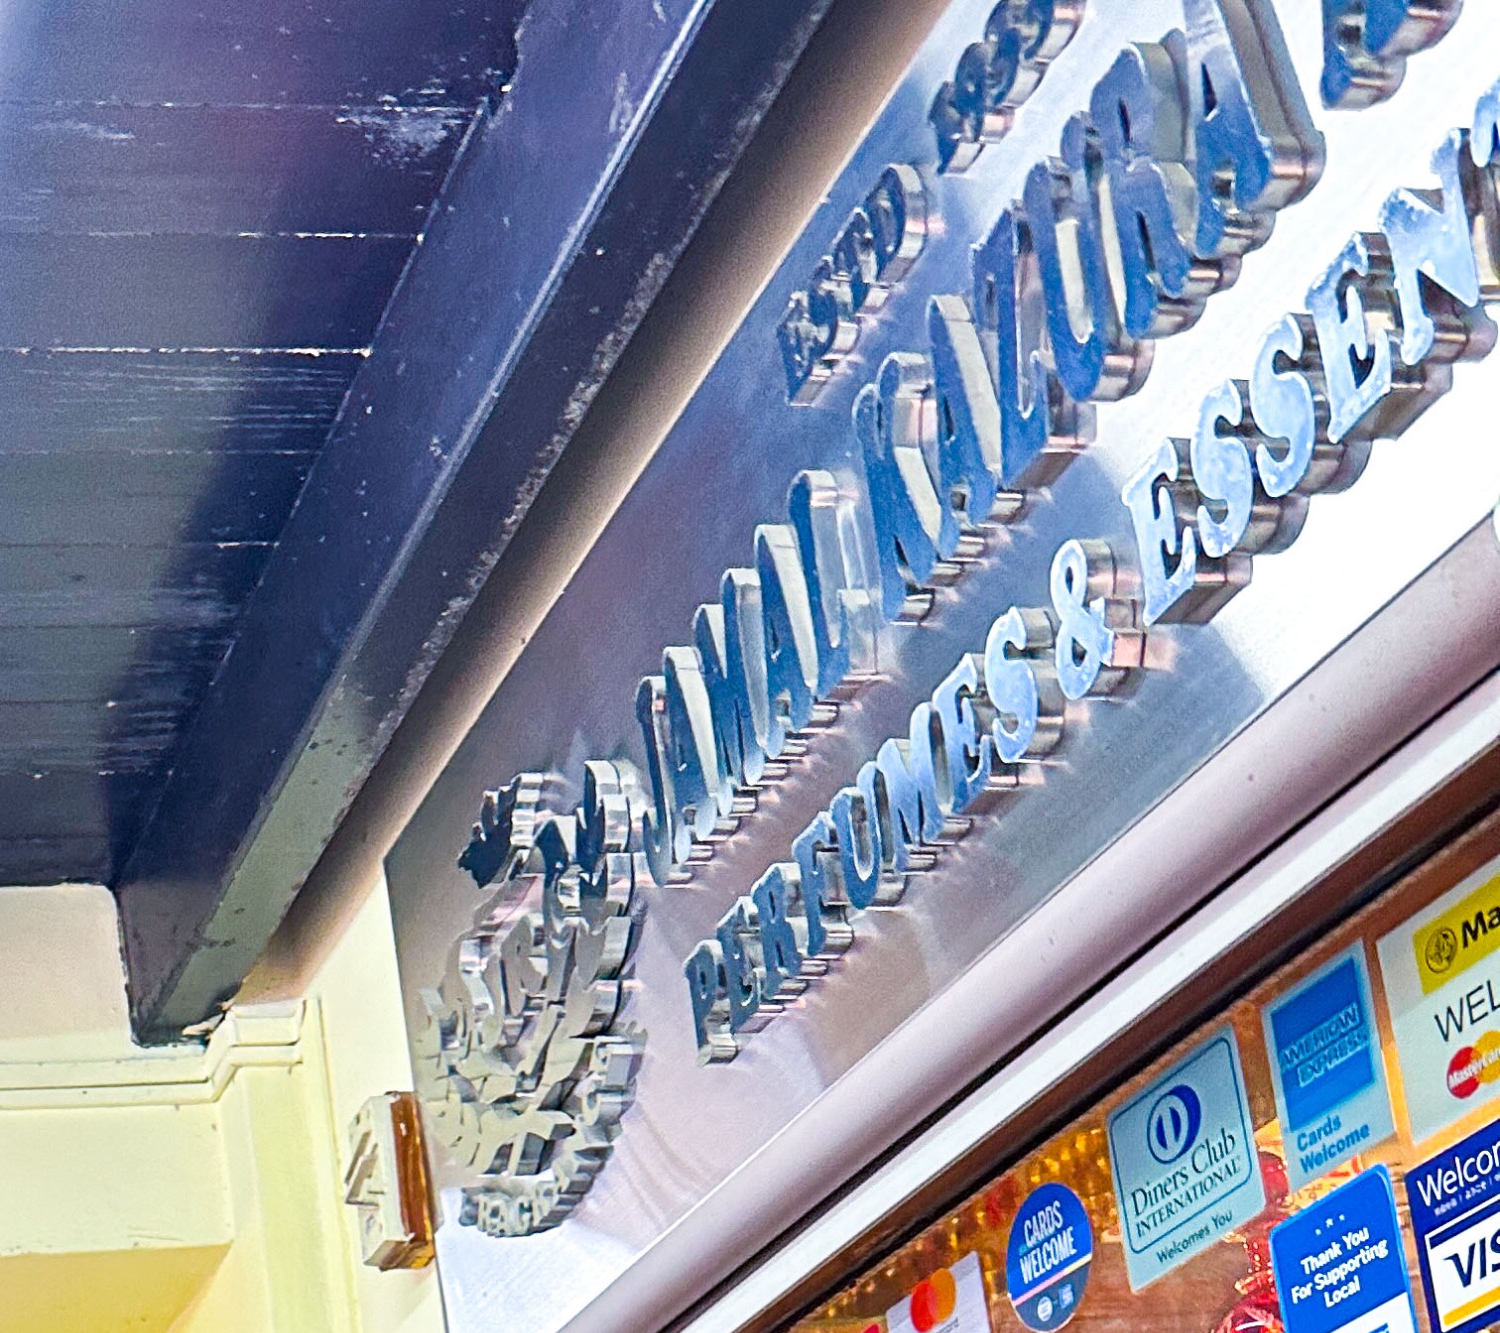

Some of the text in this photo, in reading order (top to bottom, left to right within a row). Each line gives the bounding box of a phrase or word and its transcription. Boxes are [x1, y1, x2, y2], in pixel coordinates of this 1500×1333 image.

[636, 0, 1300, 886] JAMAL KAZURA
[684, 606, 1040, 1064] PERFUMES
[1050, 539, 1118, 700] &
[1434, 979, 1500, 1043] WEL
[1297, 1115, 1341, 1150] Cards
[1300, 1123, 1370, 1173] Welcome
[1131, 1127, 1236, 1217] Diners Club
[1135, 1160, 1240, 1239] INTERNATIONAL
[1023, 1200, 1064, 1248] CARDS
[1156, 1209, 1234, 1264] Welcomes You
[1301, 1227, 1370, 1276] Thank You
[1019, 1225, 1078, 1285] WELCOME
[1290, 1239, 1390, 1305] For Supporting
[1323, 1275, 1361, 1308] Local
